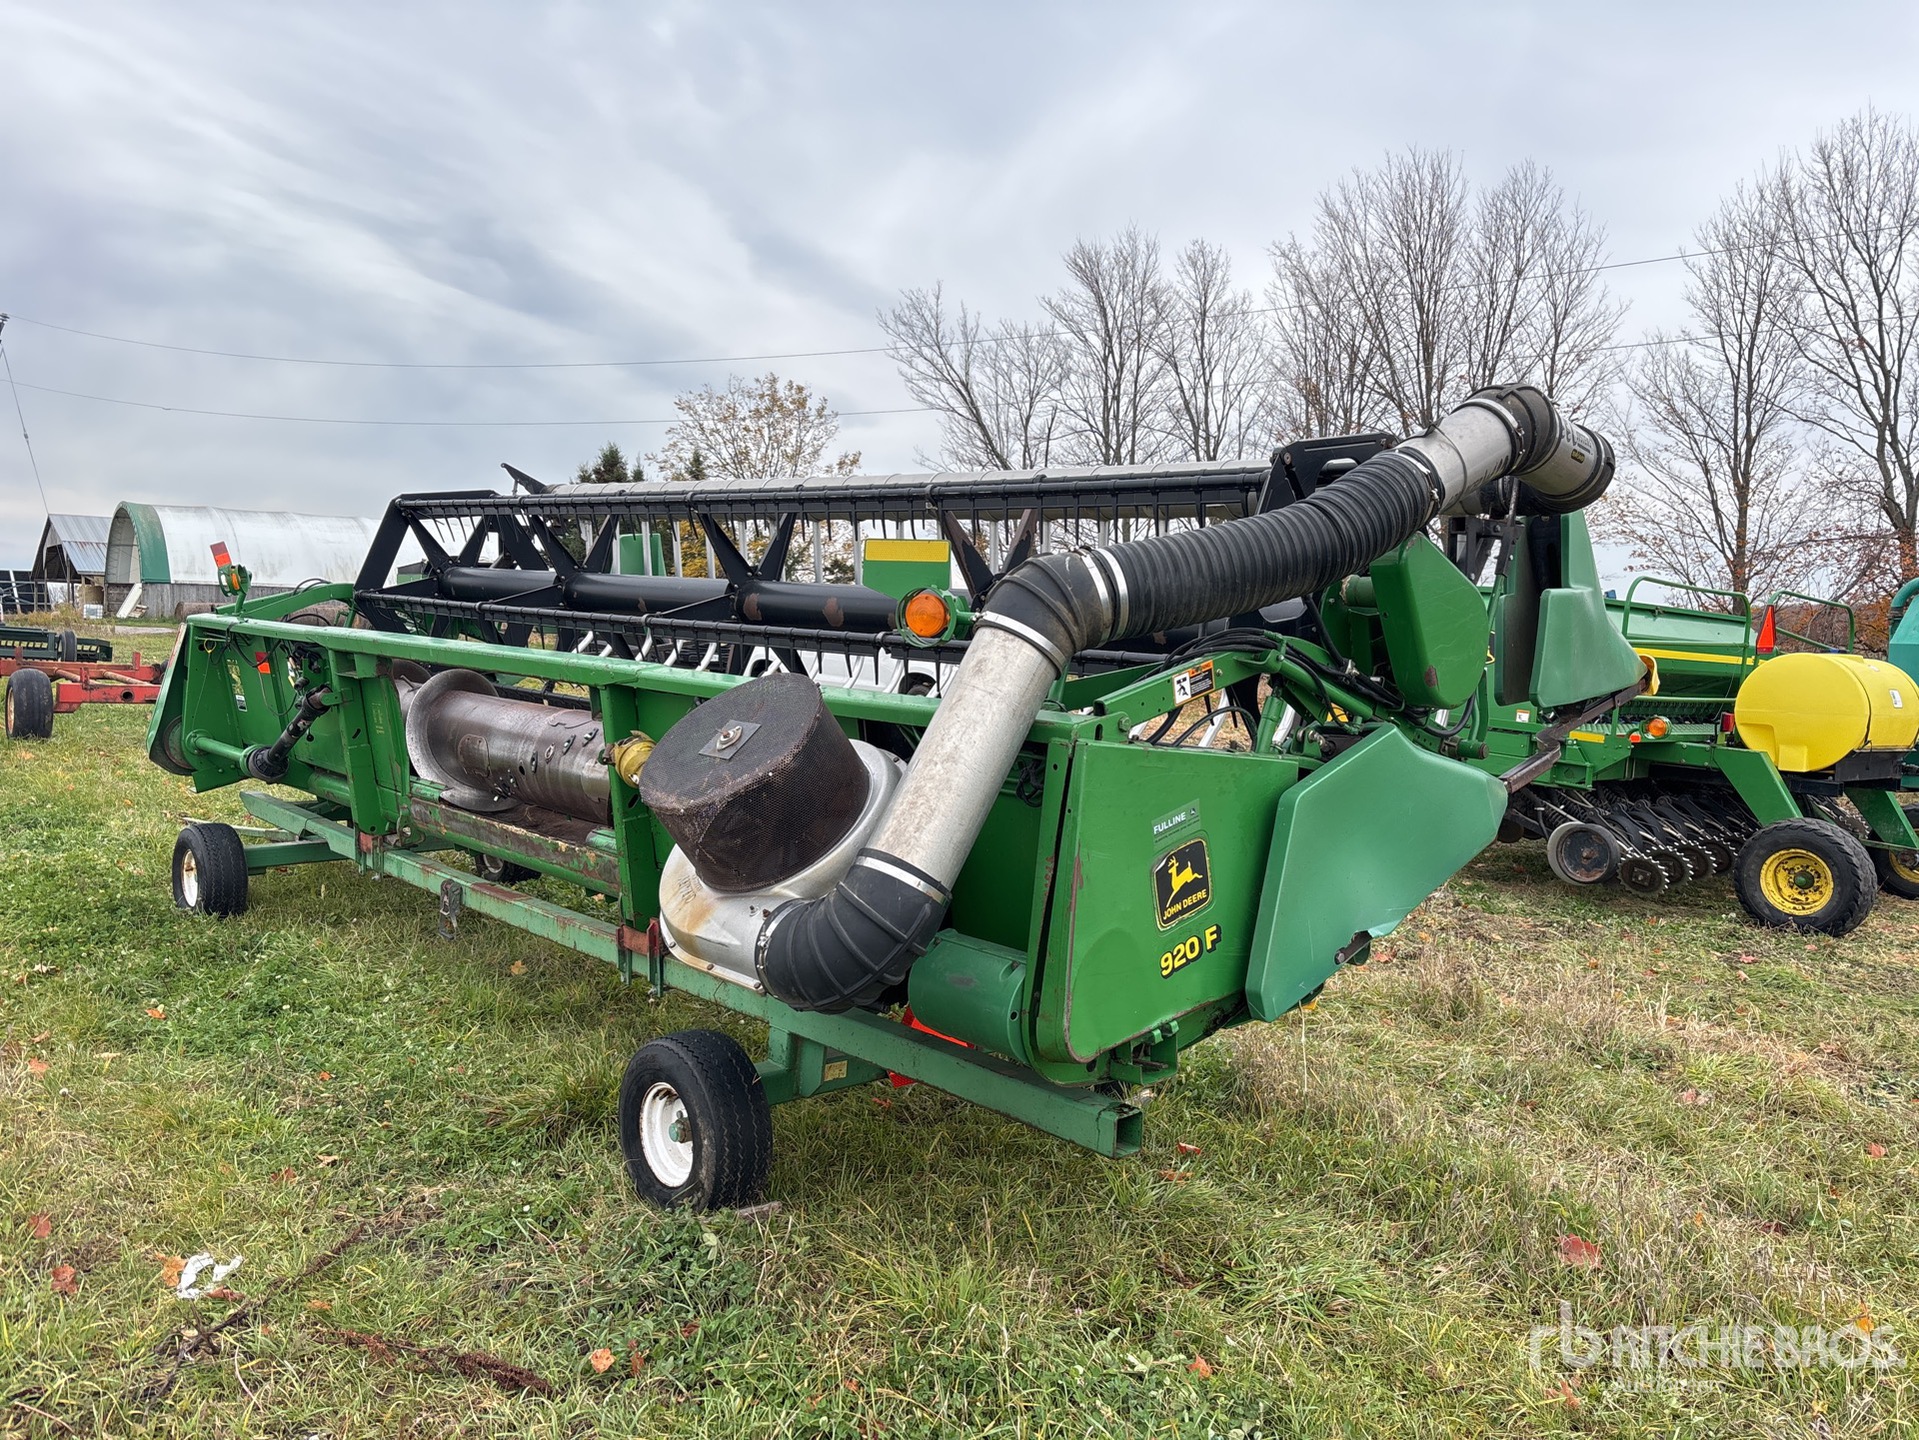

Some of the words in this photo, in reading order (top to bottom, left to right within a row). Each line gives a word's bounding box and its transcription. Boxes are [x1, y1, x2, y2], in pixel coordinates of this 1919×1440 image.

[1153, 812, 1186, 834] FULLINE
[1163, 902, 1182, 920] JOHN
[1182, 889, 1207, 909] DEERE
[1160, 936, 1202, 977] 920
[1204, 924, 1220, 952] F
